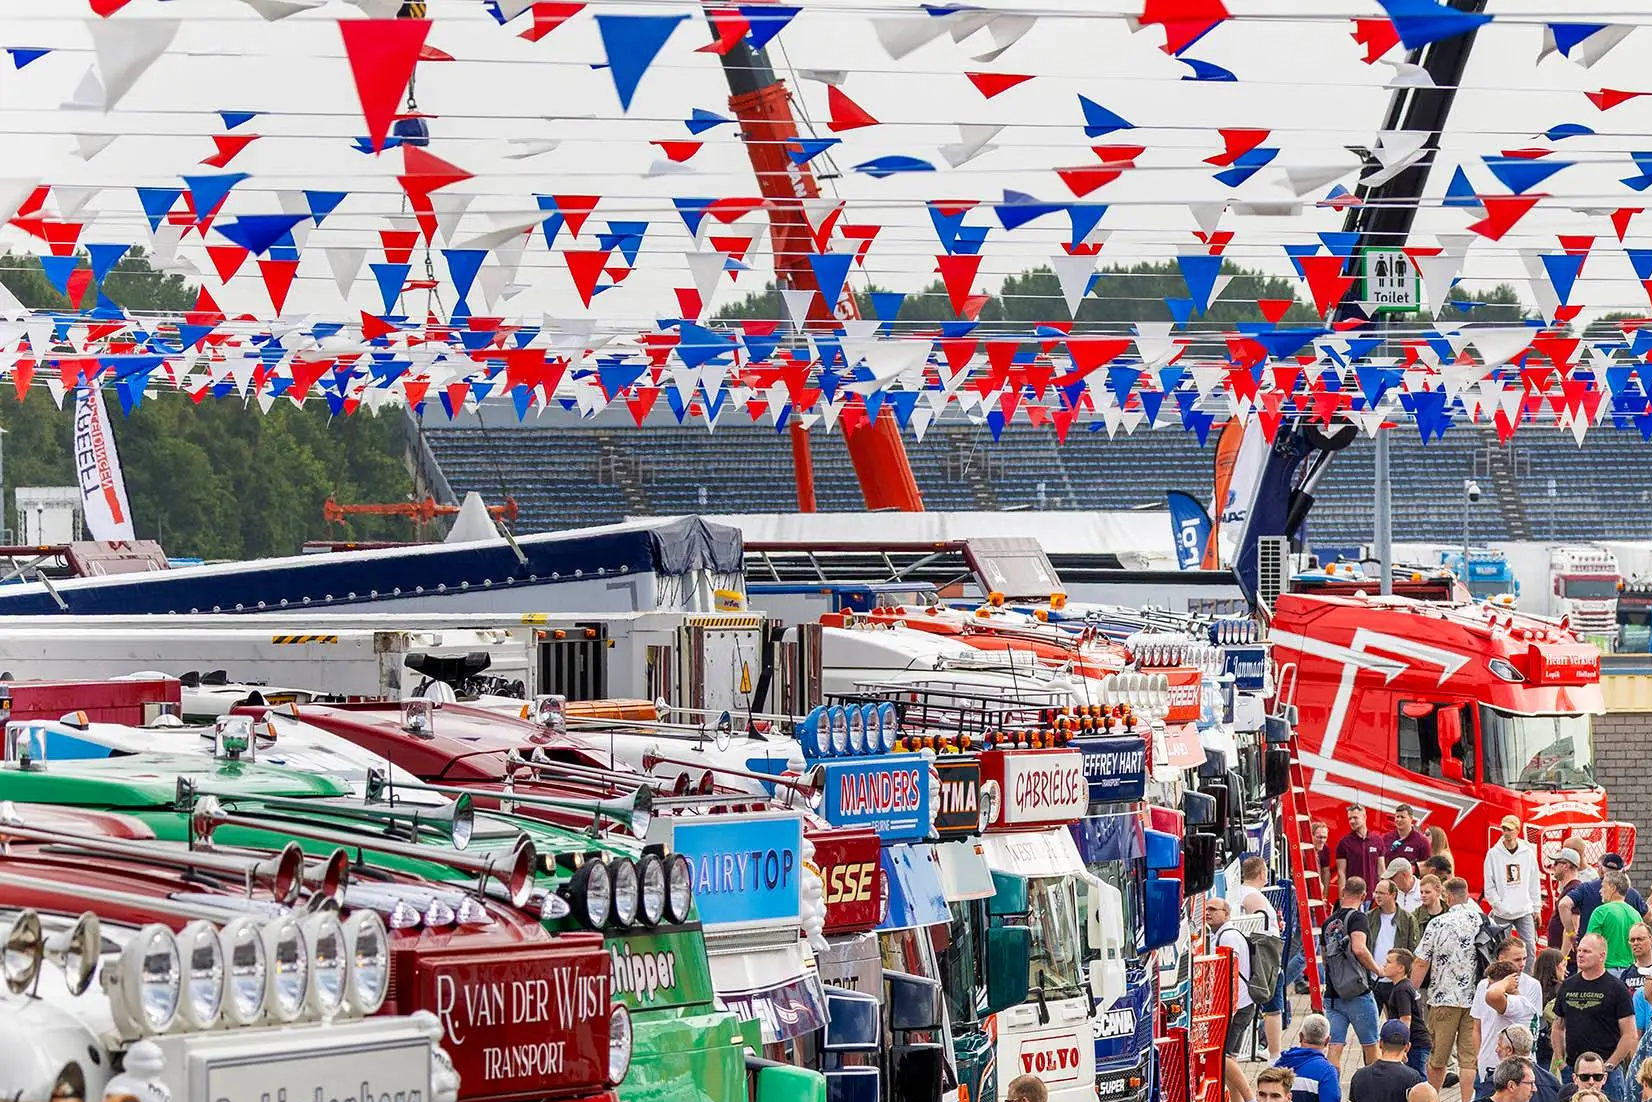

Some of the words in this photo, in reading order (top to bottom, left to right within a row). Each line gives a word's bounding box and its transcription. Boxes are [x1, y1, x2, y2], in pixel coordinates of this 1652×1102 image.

[1374, 291, 1409, 303] Toilet
[1119, 751, 1144, 775] HART
[840, 768, 921, 816] MANDERS
[942, 781, 977, 813] TMA
[1016, 764, 1079, 813] GABRIËLSE
[464, 982, 505, 1027] VAN
[512, 979, 549, 1024] DER
[1580, 991, 1604, 999] LEGEND
[1094, 1010, 1136, 1039] SCANIA
[483, 1041, 566, 1080] TRANSPORT
[1021, 1047, 1080, 1073] VOLVO
[1100, 1078, 1126, 1094] SUPER
